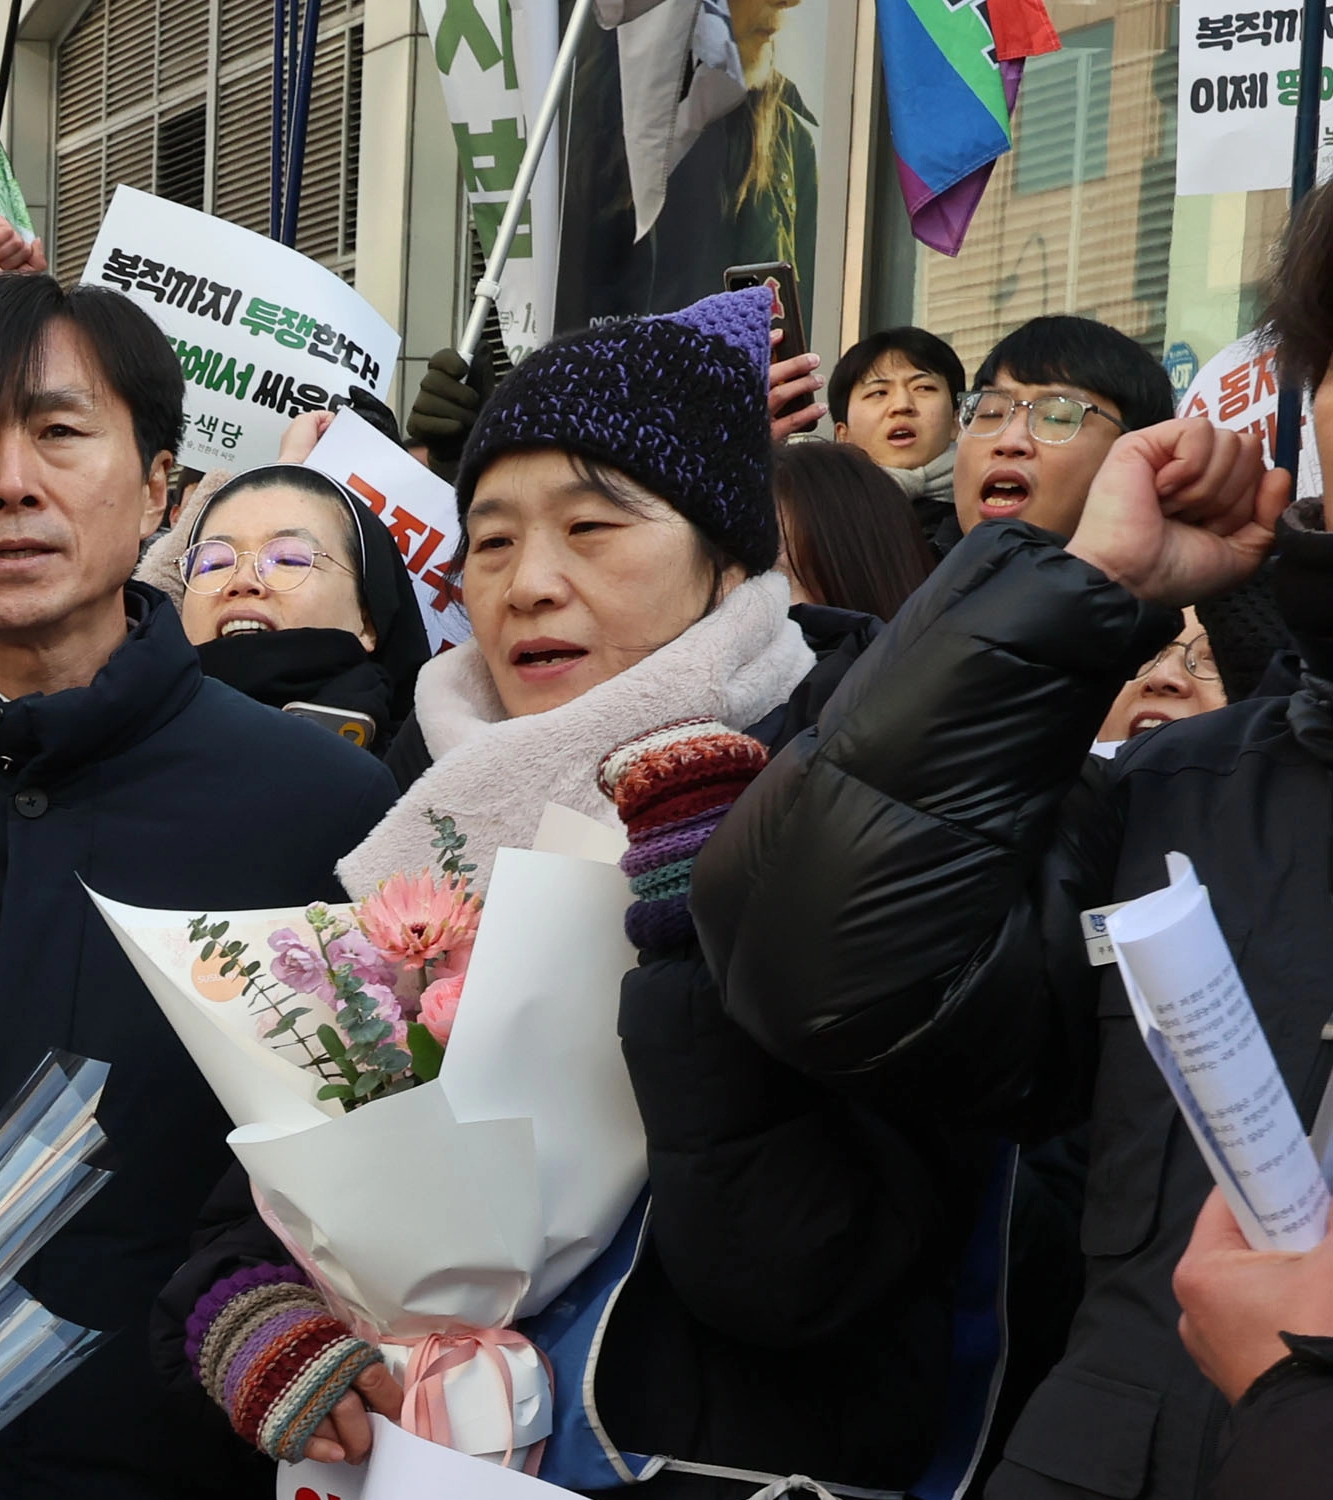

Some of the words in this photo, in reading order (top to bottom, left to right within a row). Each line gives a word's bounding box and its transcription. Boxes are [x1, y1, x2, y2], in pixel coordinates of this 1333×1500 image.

[1190, 72, 1268, 113] 이제
[102, 249, 242, 325] 복직까지
[240, 297, 380, 389] 투쟁한다!
[252, 370, 349, 419] 싸운
